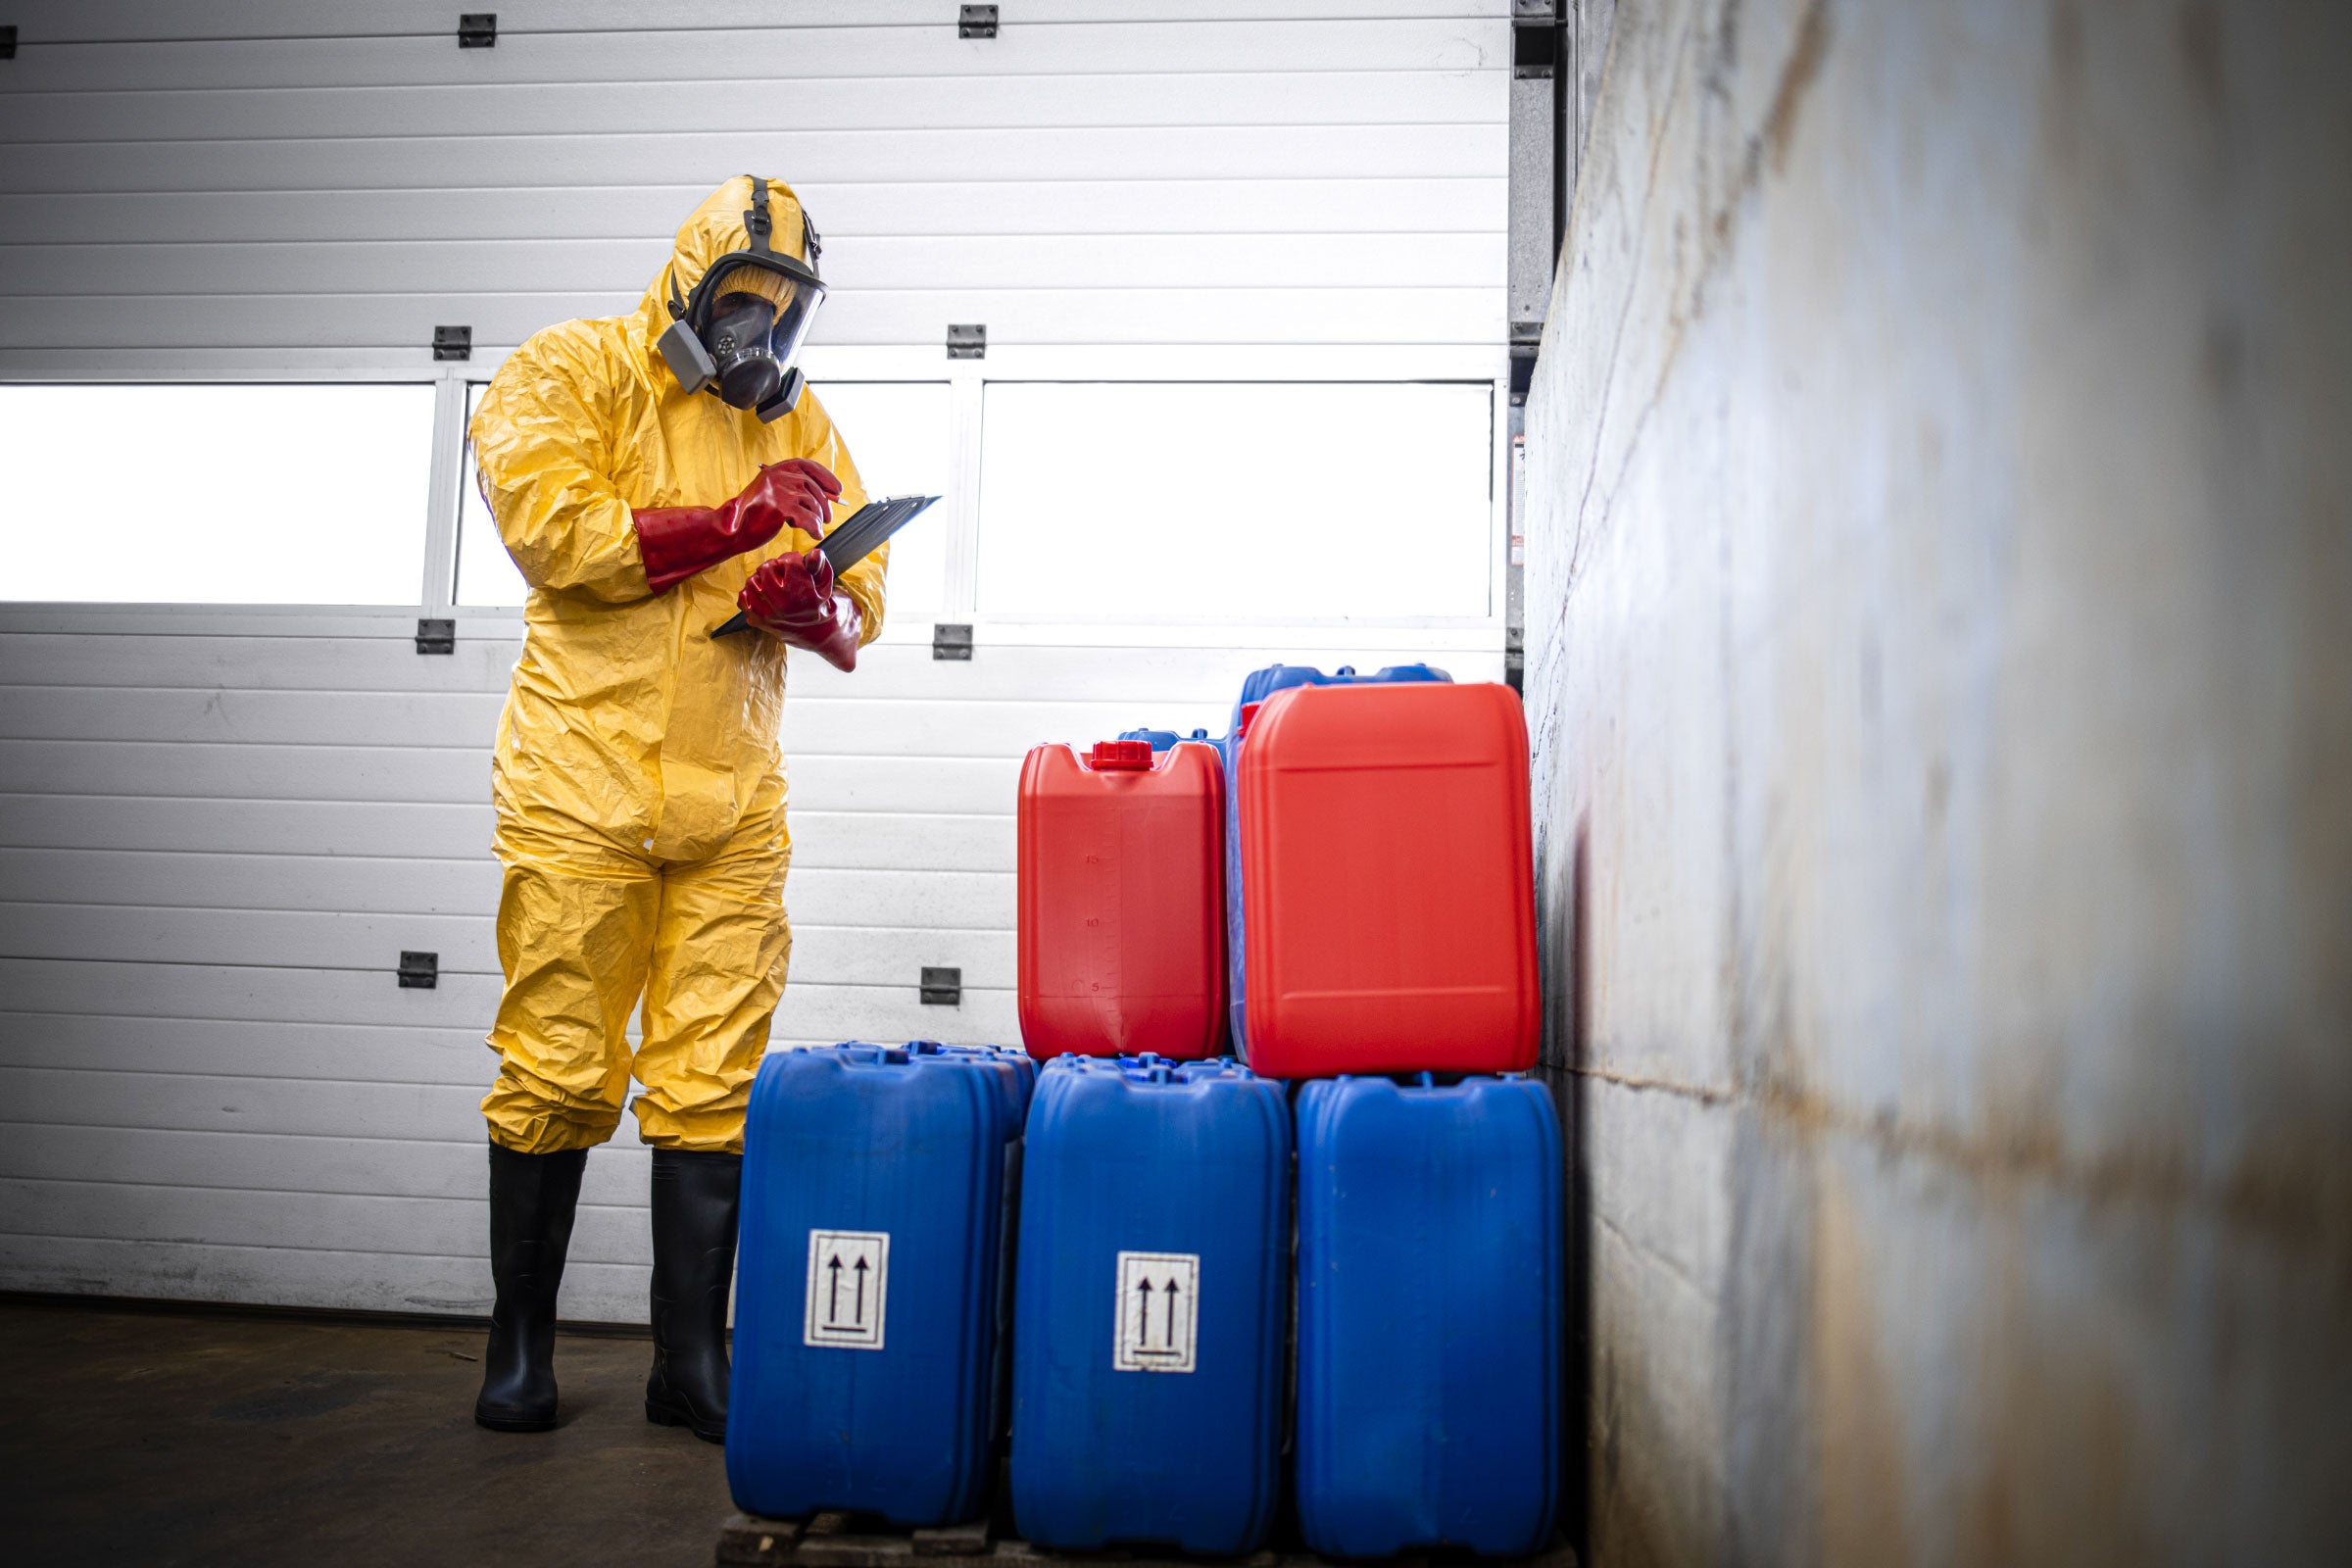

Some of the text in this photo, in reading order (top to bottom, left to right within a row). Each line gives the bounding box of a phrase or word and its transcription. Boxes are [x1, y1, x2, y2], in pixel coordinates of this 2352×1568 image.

[1085, 855, 1099, 864] 15
[1086, 917, 1099, 927] 10
[1091, 983, 1100, 992] 5
